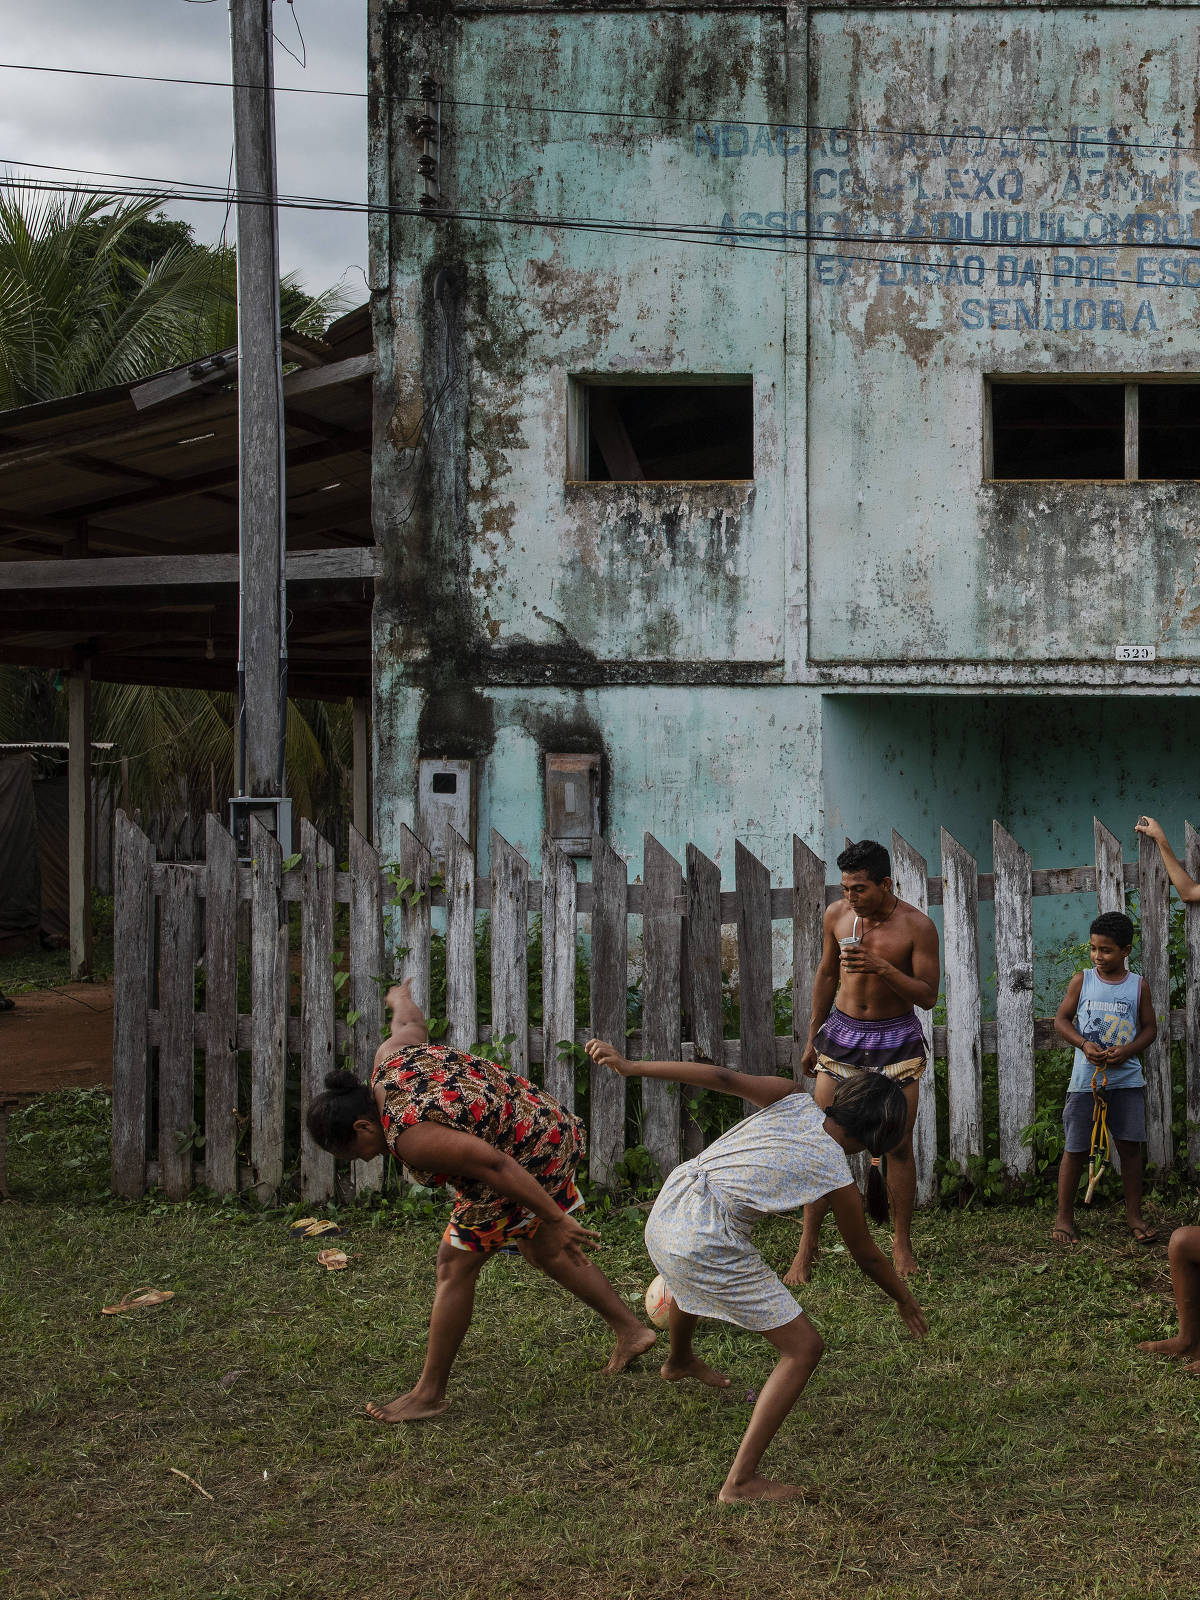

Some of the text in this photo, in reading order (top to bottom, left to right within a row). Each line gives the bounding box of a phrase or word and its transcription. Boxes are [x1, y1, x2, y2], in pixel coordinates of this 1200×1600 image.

[813, 167, 1024, 200] COLEXO
[997, 255, 1036, 287] DA
[961, 298, 1161, 331] SENHORA
